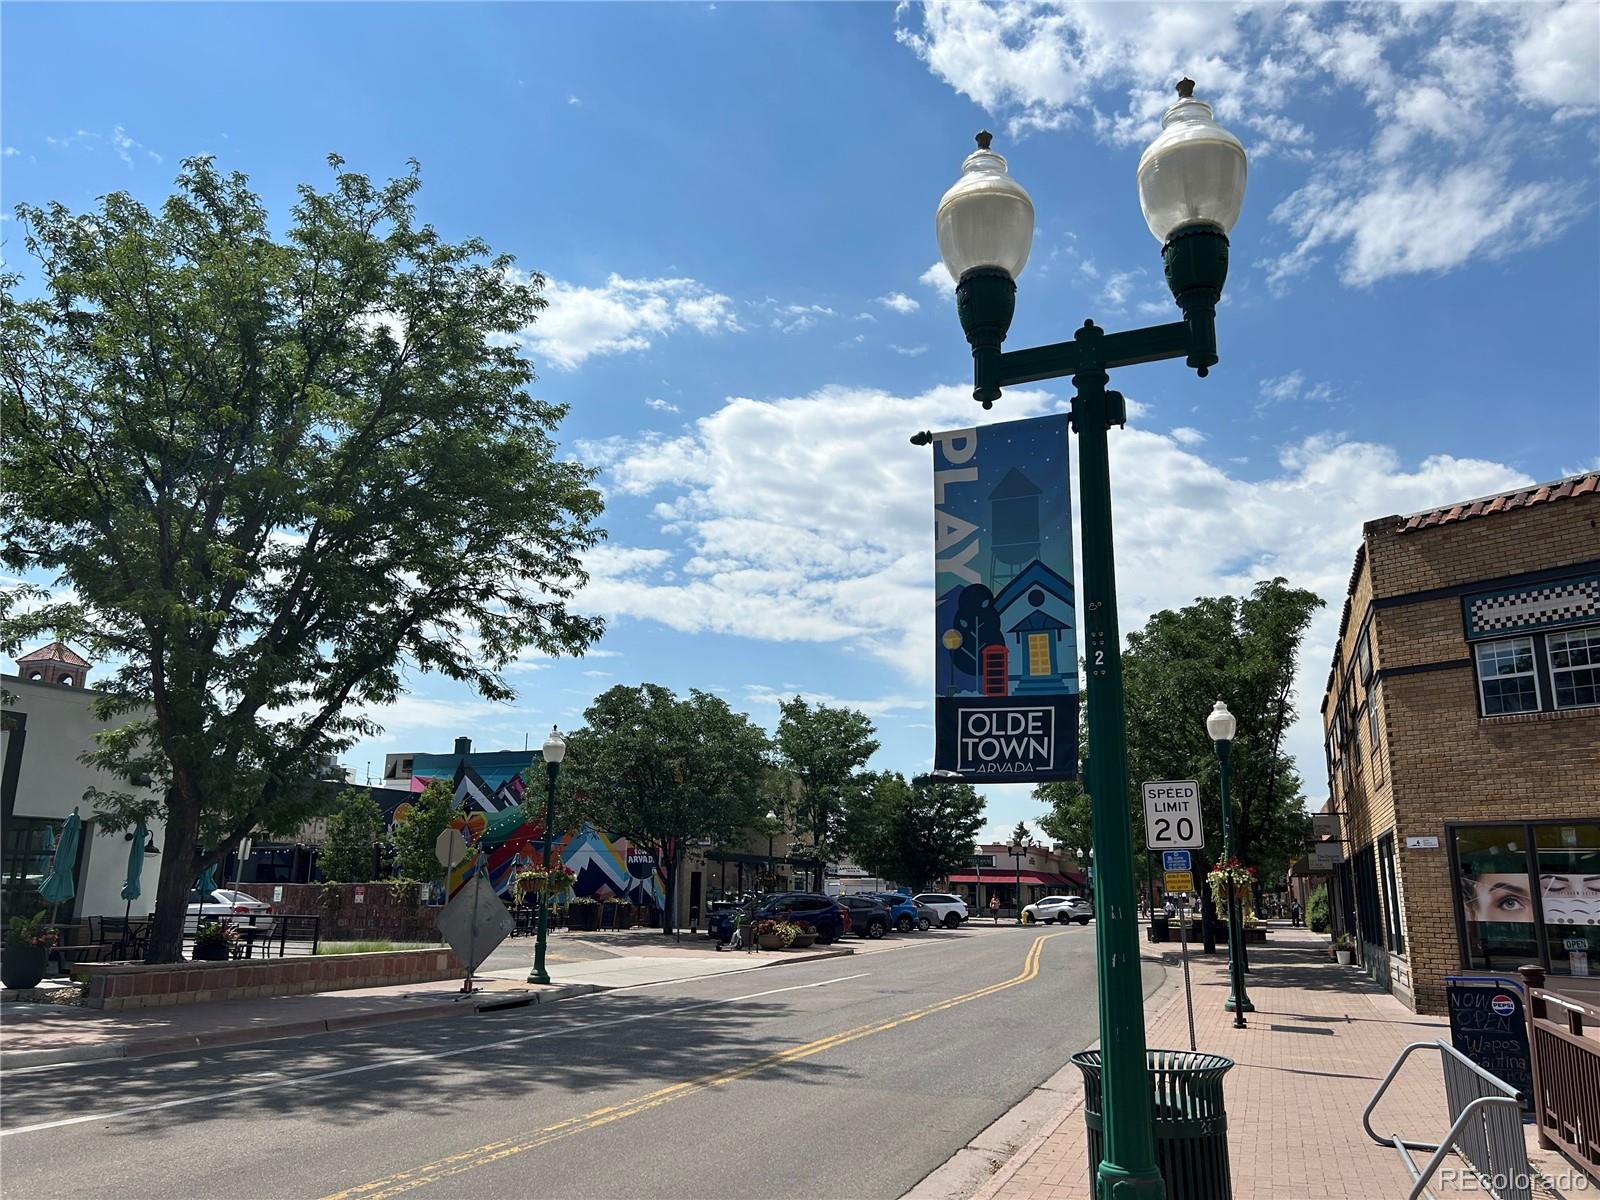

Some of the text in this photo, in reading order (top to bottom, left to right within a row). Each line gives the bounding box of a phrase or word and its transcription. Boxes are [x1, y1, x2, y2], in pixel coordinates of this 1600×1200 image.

[932, 427, 981, 585] PLAY
[1094, 650, 1104, 665] 2
[968, 712, 1043, 736] OLDE
[962, 737, 1048, 760] TOWN
[976, 762, 1034, 774] ARVADA
[1148, 788, 1193, 799] SPEED
[1154, 801, 1189, 813] LIMIT
[1154, 817, 1194, 842] 20
[628, 855, 655, 864] ARVAD
[1565, 940, 1587, 949] OPEN
[1451, 992, 1490, 1009] NOW
[1457, 1009, 1511, 1032] OPEN
